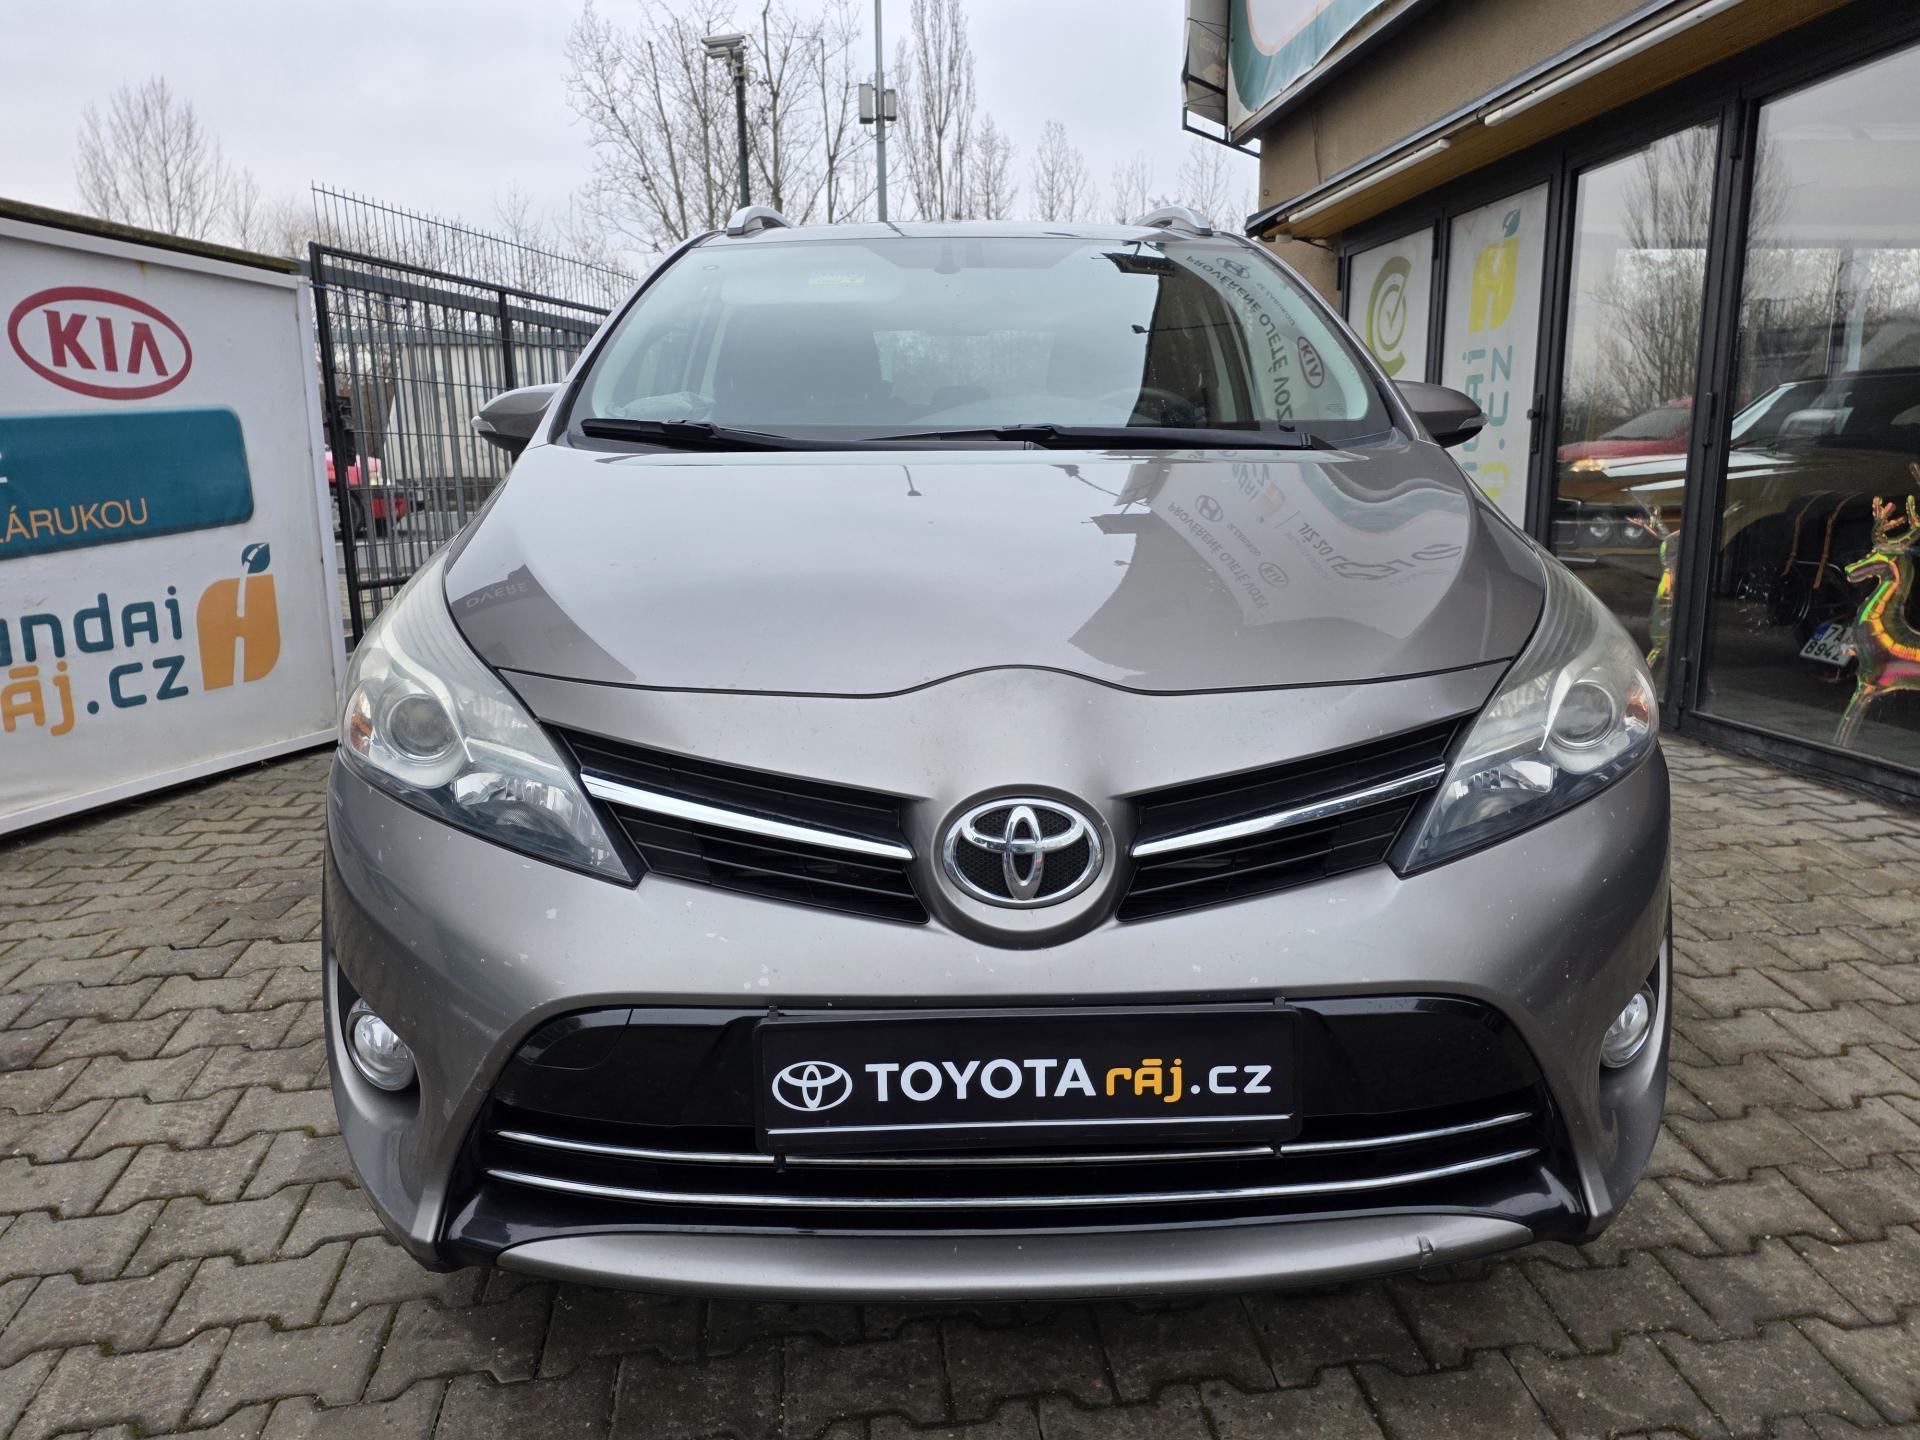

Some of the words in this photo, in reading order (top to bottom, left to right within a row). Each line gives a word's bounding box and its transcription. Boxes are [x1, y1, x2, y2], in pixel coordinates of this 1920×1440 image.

[43, 309, 168, 376] KIA
[0, 498, 148, 543] ÁRUKOU
[0, 585, 182, 667] ndai
[865, 1058, 1096, 1101] TOYOTA
